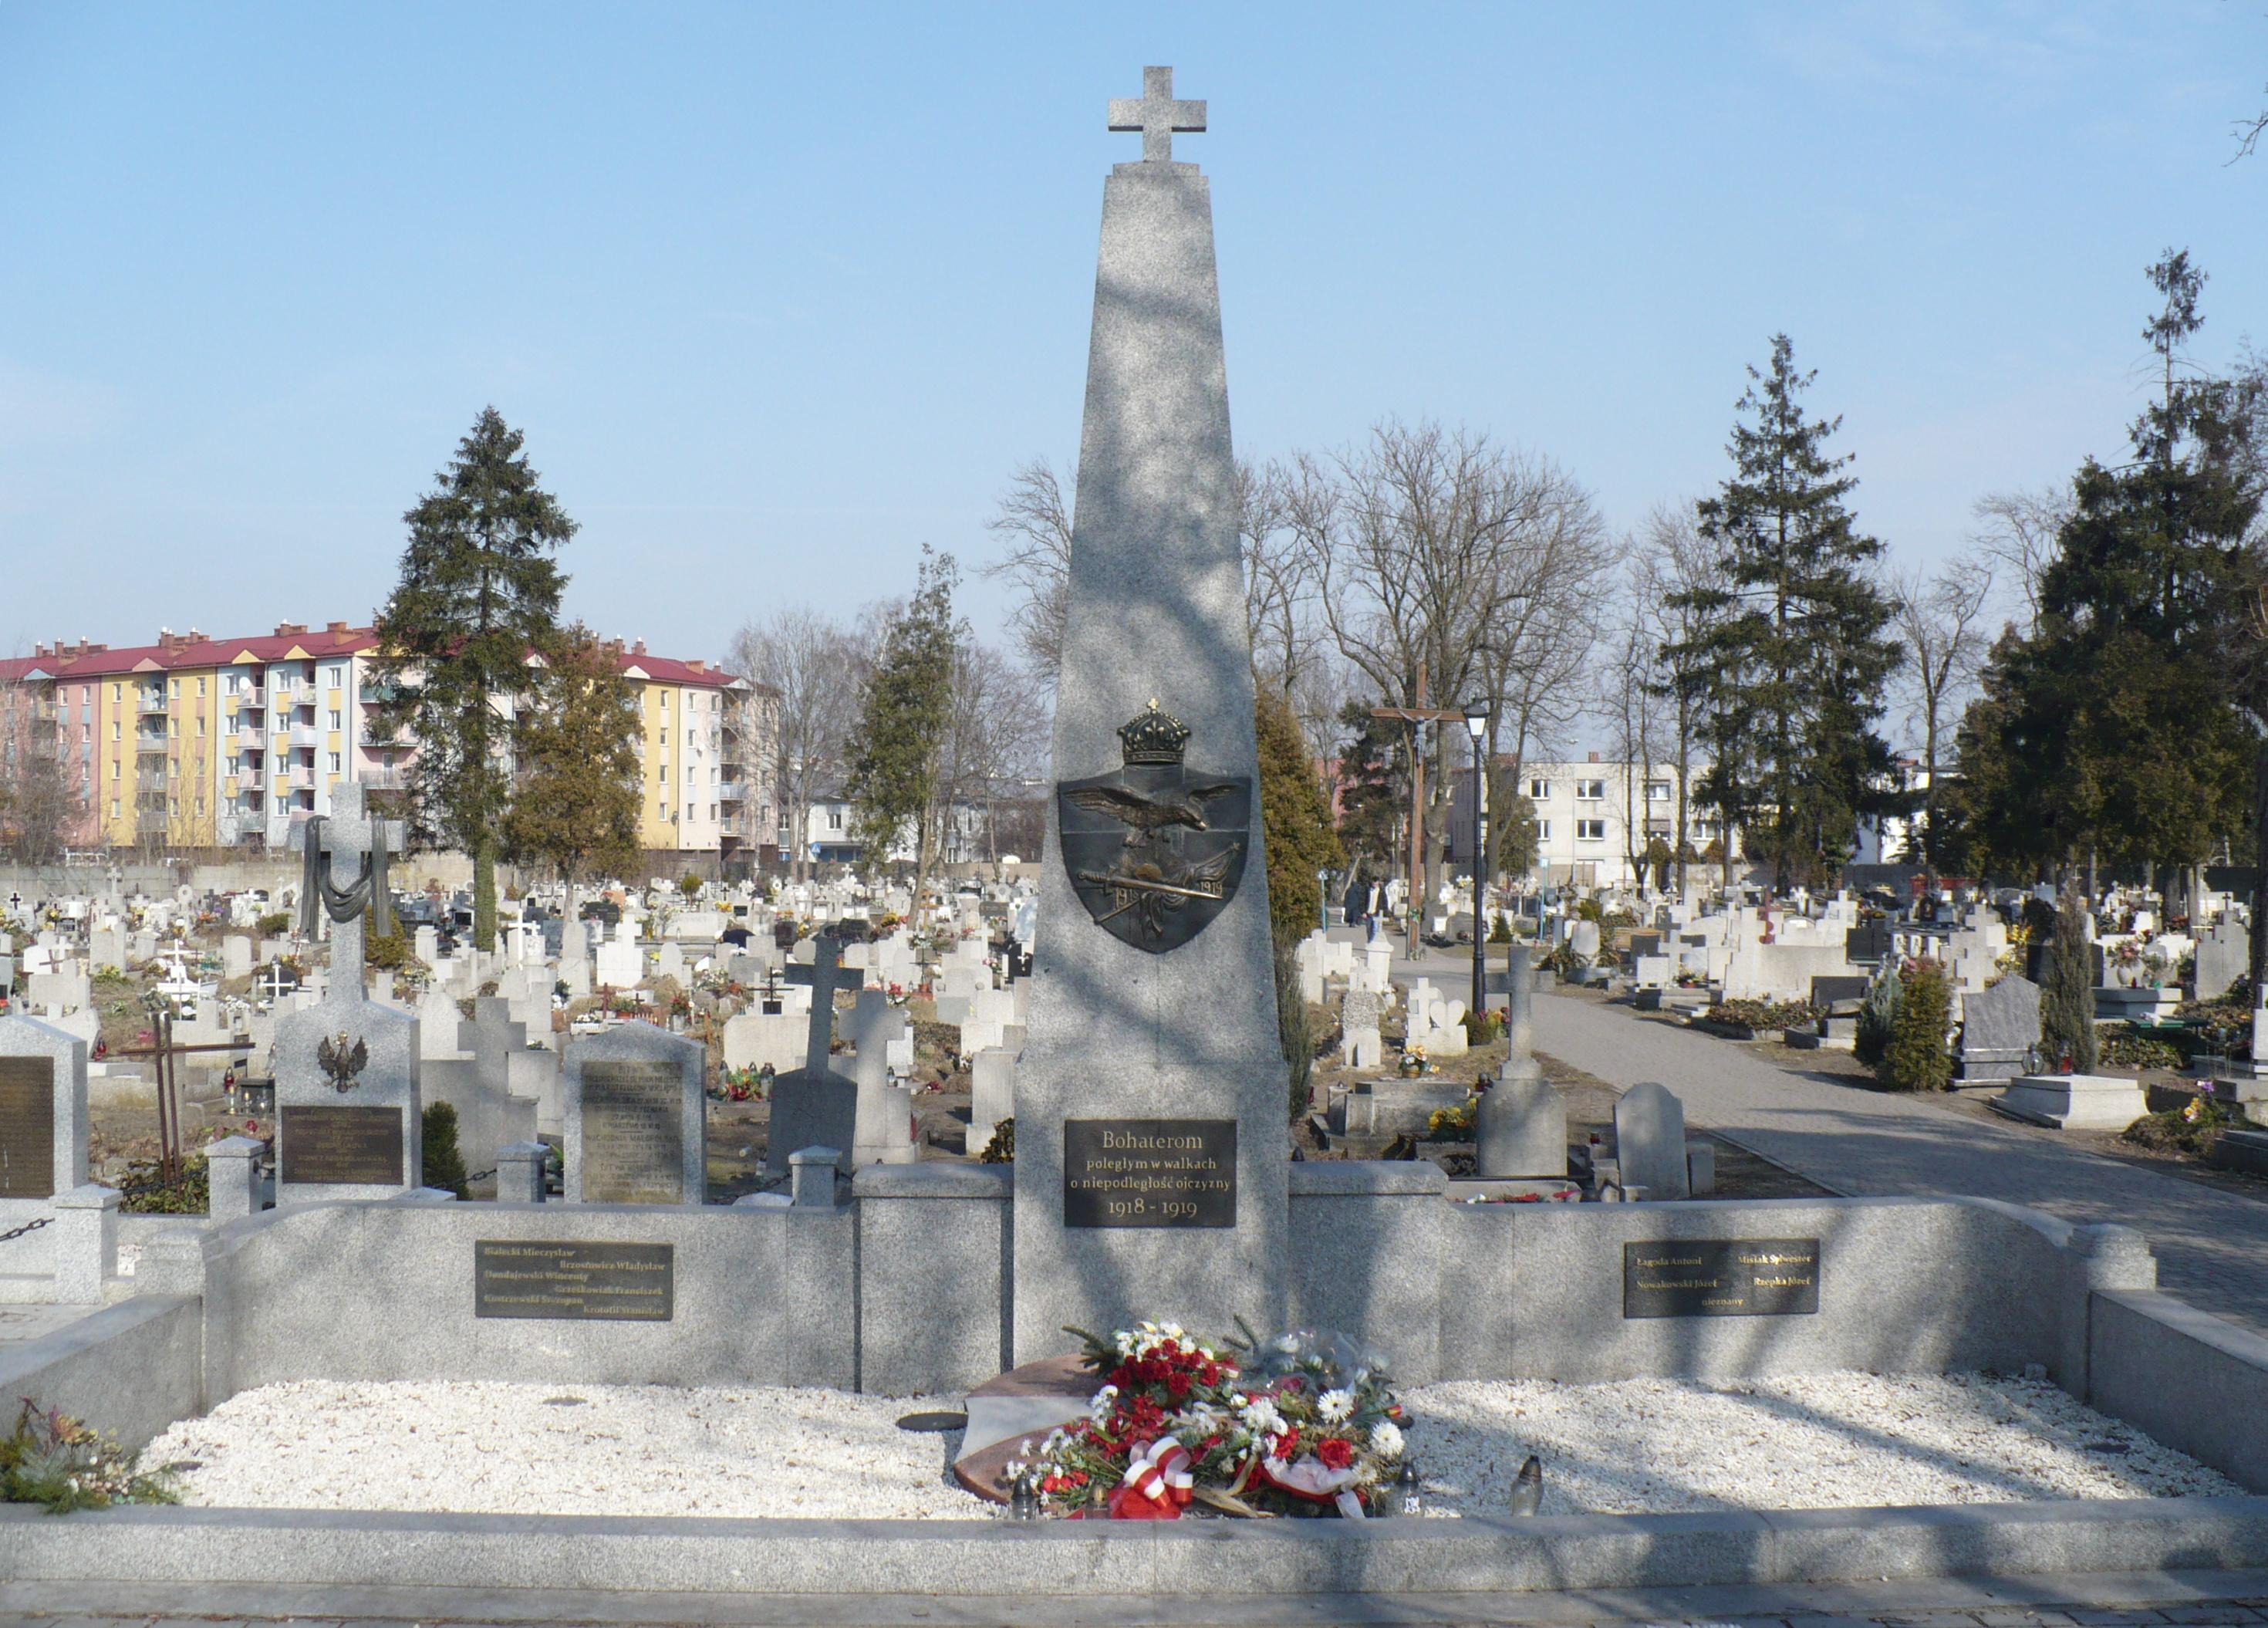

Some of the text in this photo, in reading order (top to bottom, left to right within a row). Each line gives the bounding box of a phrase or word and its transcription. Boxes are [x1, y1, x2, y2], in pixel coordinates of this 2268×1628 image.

[1200, 881, 1223, 896] 1919
[1102, 1130, 1203, 1149] Bohaterom
[1086, 1157, 1217, 1172] poległym w walkach
[1071, 1176, 1230, 1192] o niepodległość ojczyzny
[1109, 1197, 1145, 1217] 1918
[1163, 1201, 1197, 1218] 1919
